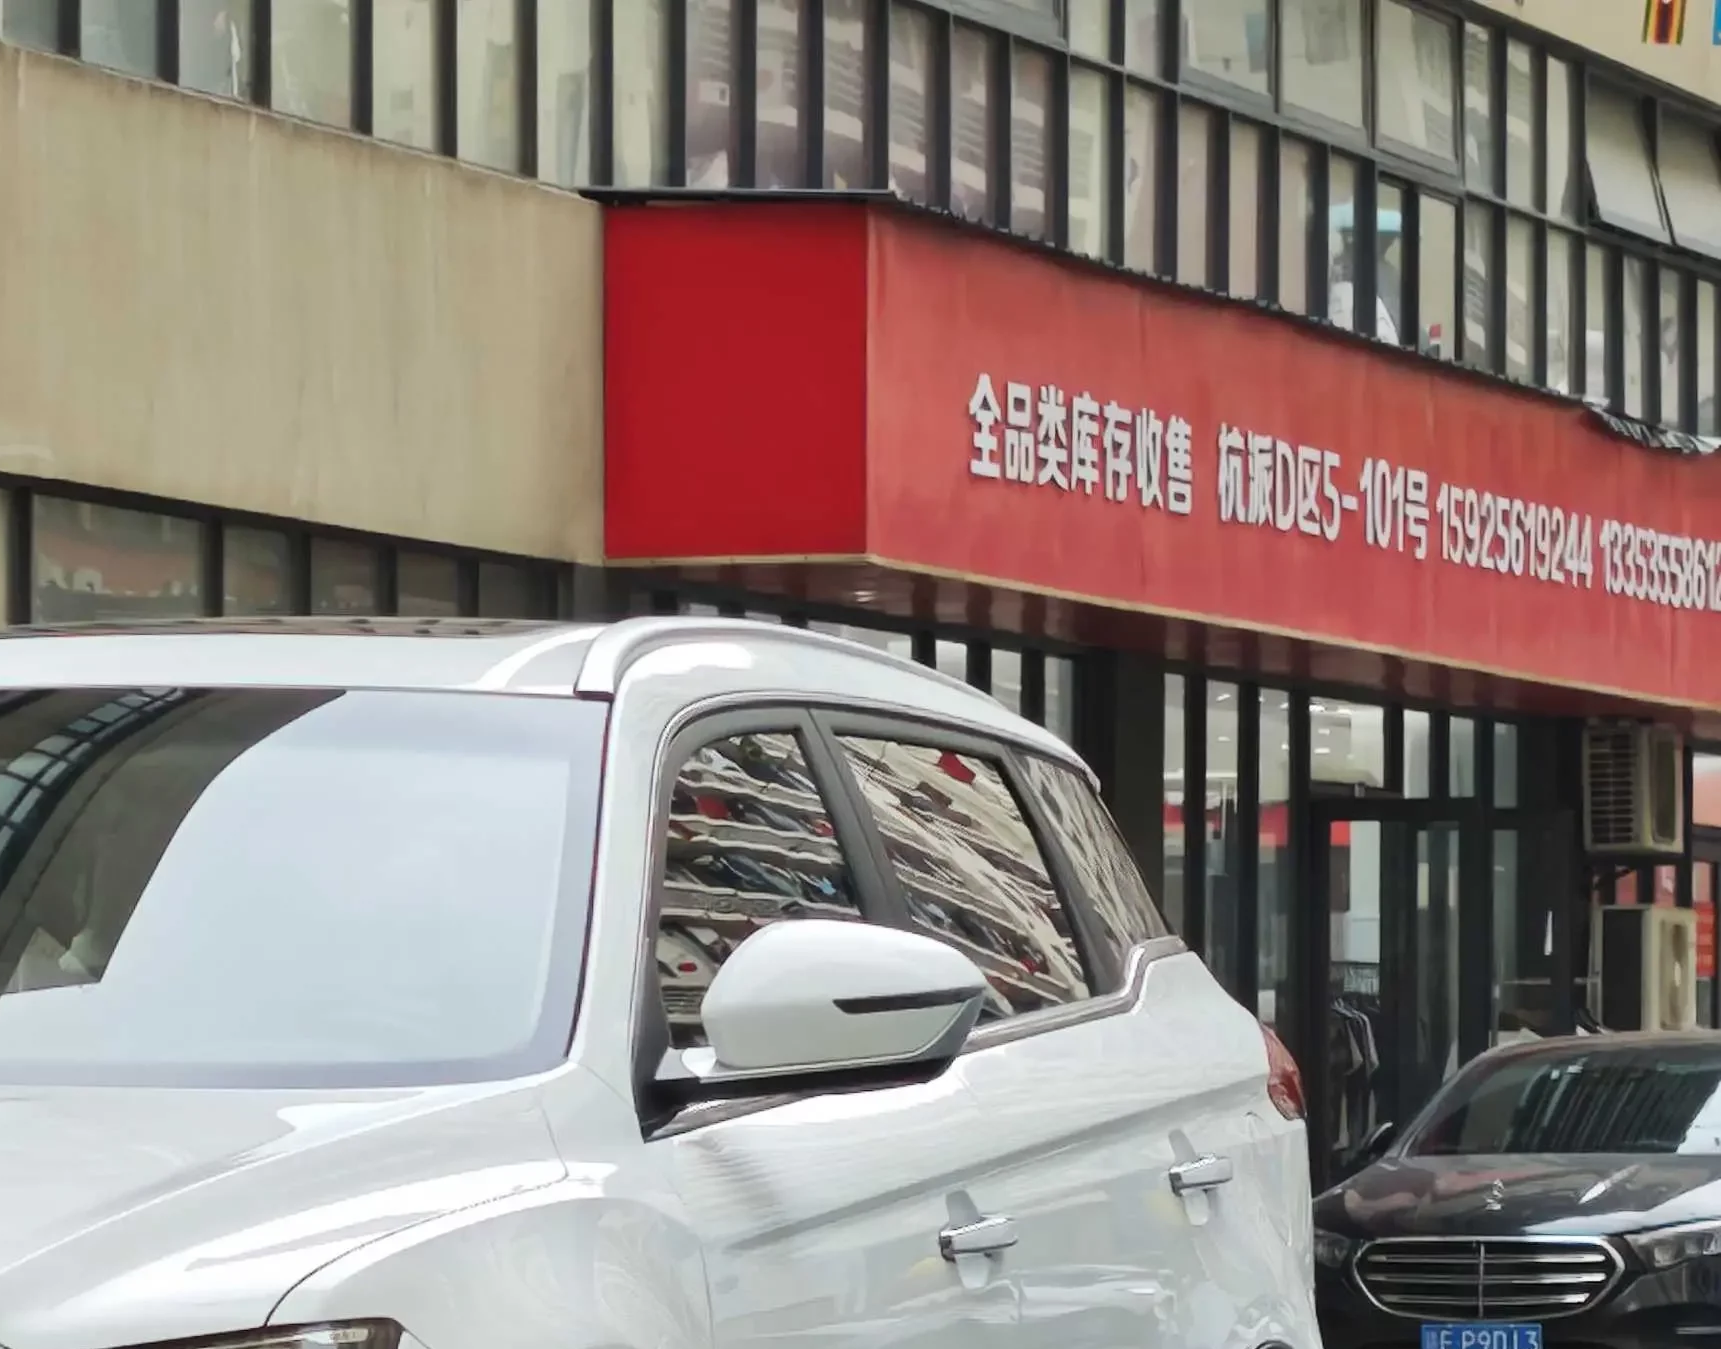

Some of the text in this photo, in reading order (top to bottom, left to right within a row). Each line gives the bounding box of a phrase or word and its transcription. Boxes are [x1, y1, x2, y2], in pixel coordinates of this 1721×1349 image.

[969, 373, 1192, 515] 全品类库存收售
[1218, 421, 1430, 560] 杭派D区5-101号
[1436, 482, 1593, 589] 15925619244
